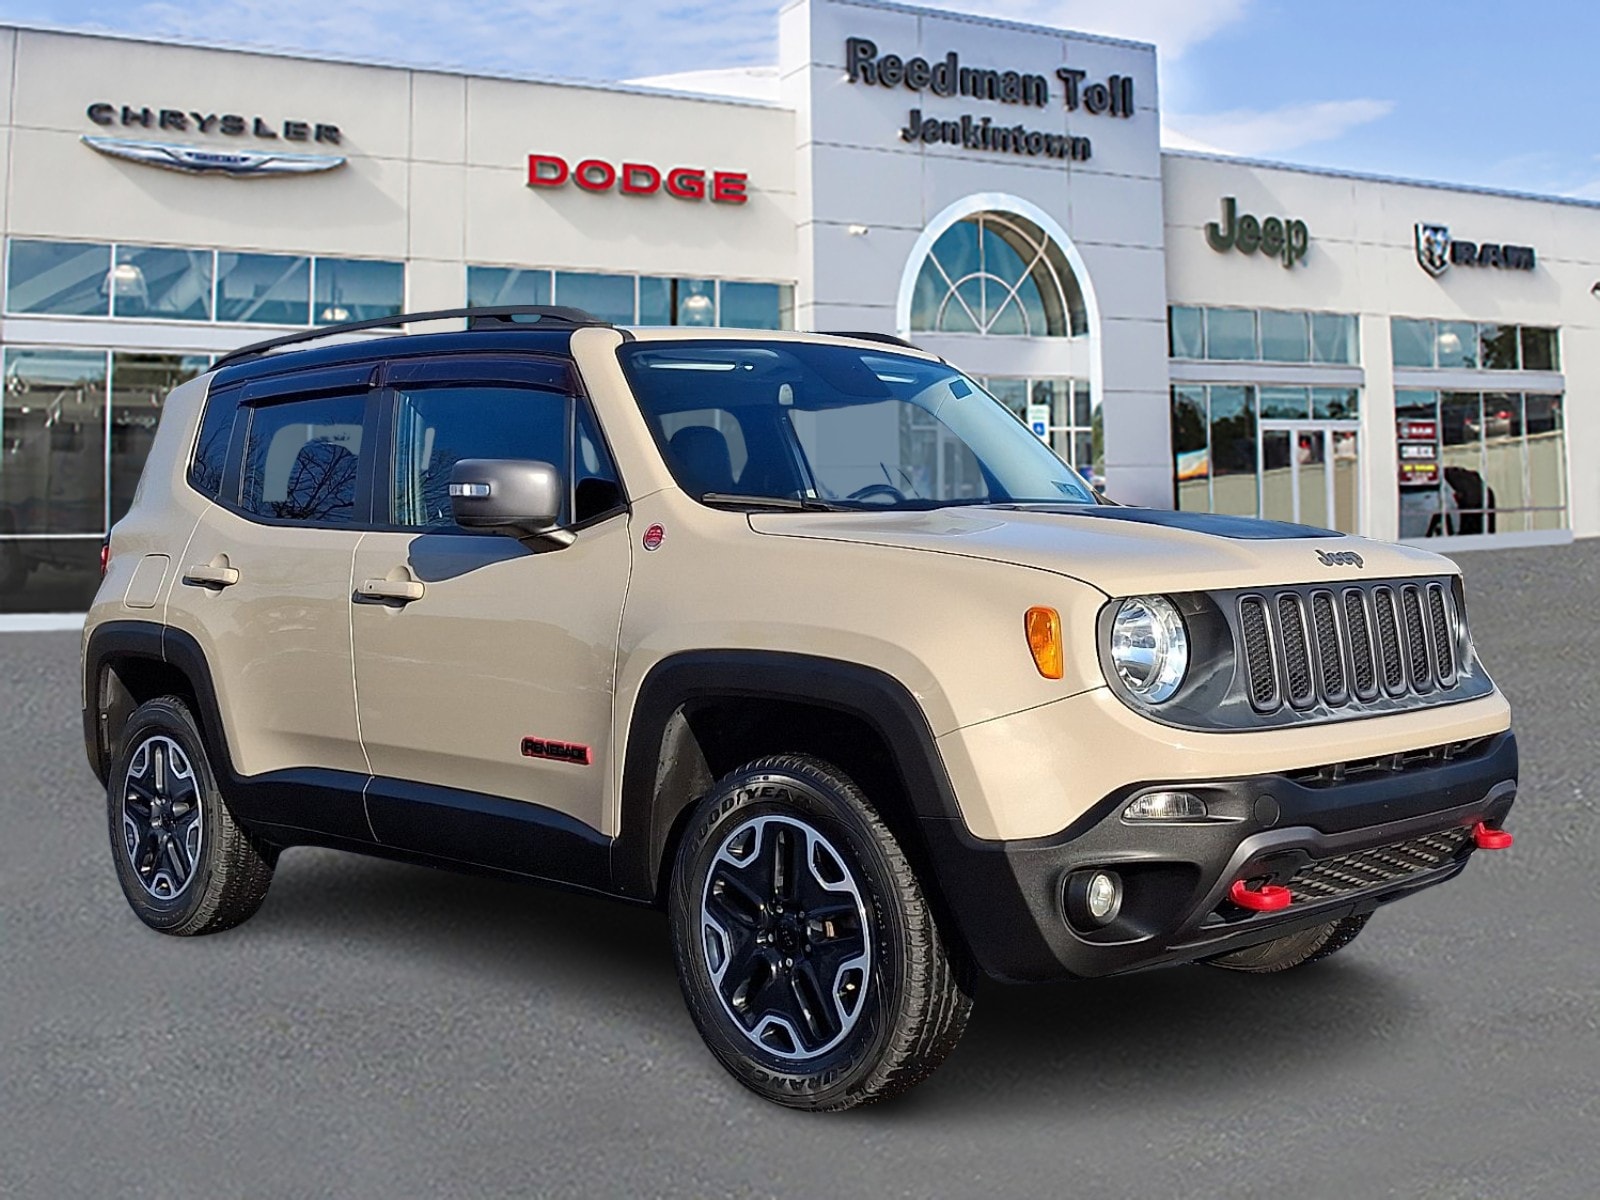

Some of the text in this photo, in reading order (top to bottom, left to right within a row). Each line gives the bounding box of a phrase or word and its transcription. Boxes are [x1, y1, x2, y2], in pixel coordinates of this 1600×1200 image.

[846, 37, 1134, 118] Reedman Toll
[87, 103, 341, 144] CHRYSLER
[901, 108, 1092, 161] Jenkintown
[527, 154, 748, 204] DODGE
[1204, 197, 1308, 269] Jeep
[1450, 240, 1536, 270] RAM
[1315, 549, 1364, 569] Jeep
[521, 737, 590, 765] RENEGADE
